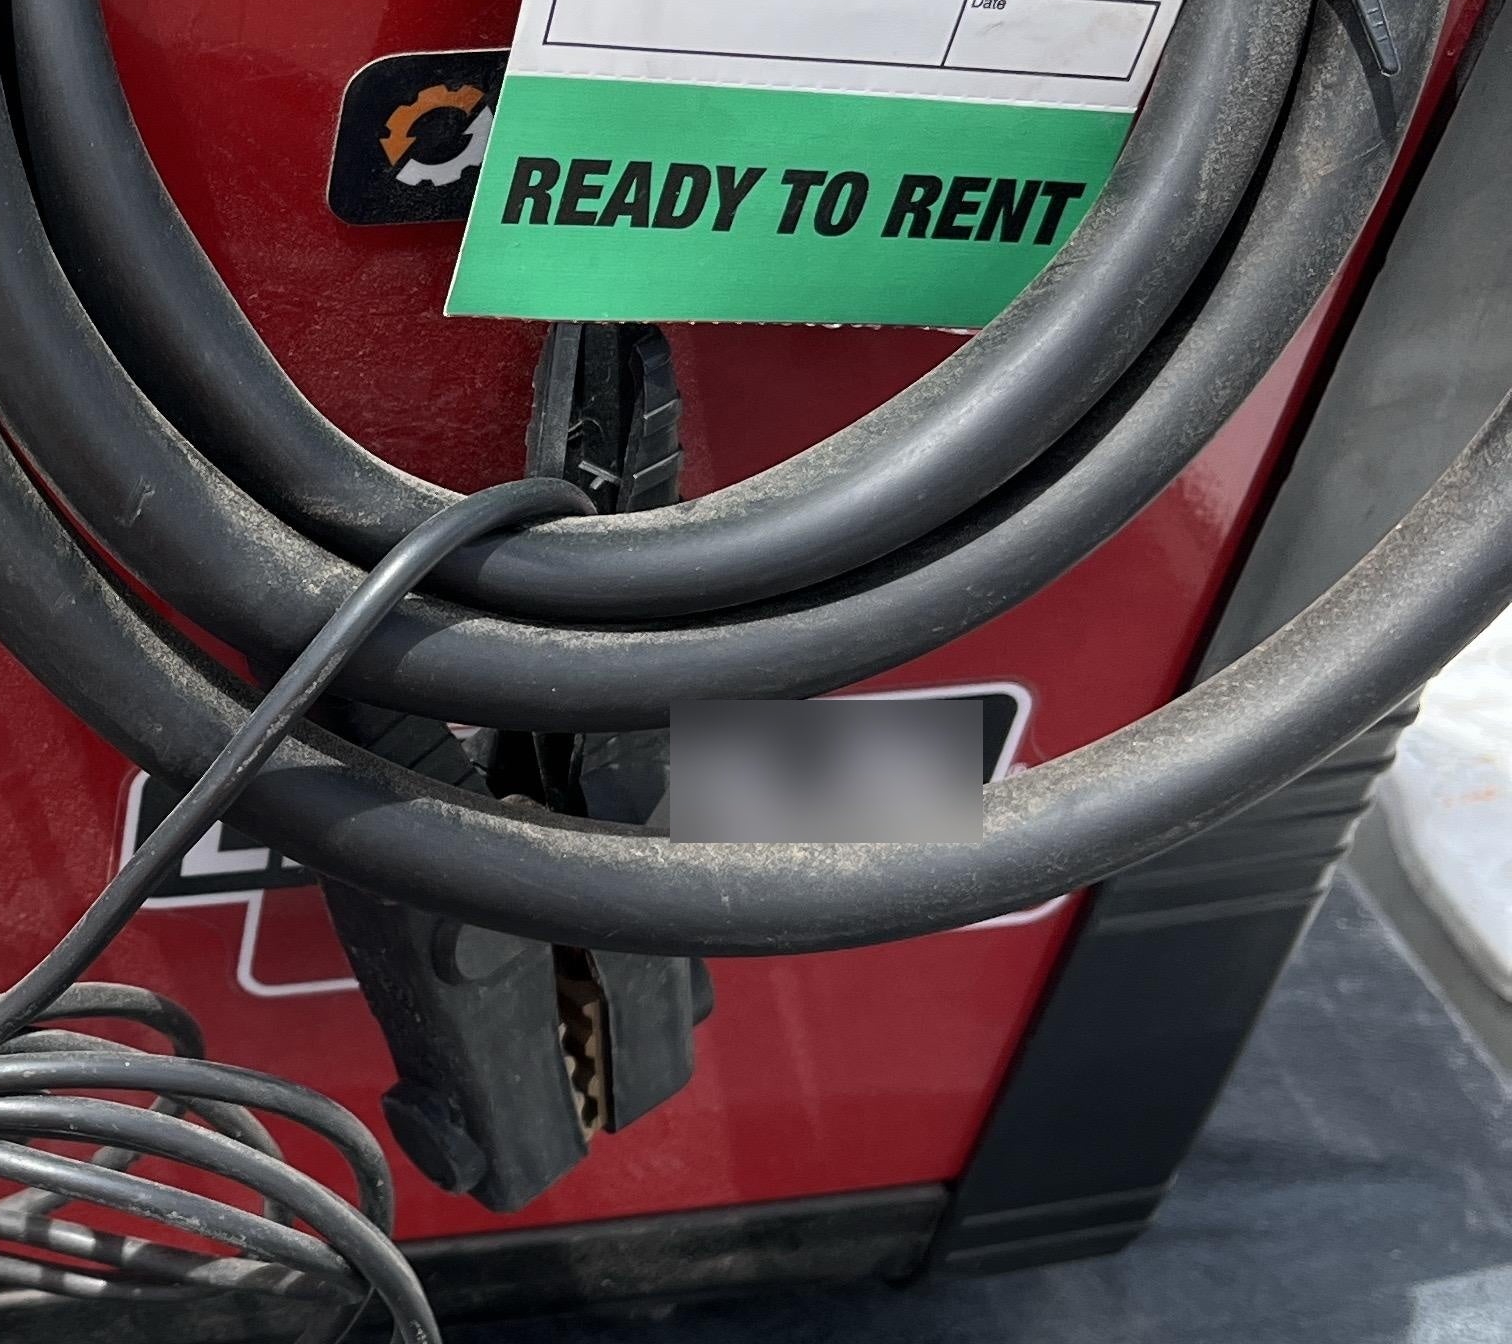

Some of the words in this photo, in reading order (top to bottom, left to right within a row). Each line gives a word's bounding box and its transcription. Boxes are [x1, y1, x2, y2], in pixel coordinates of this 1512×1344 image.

[500, 156, 768, 233] READY
[777, 168, 869, 238] TO
[880, 173, 1088, 246] RENT
